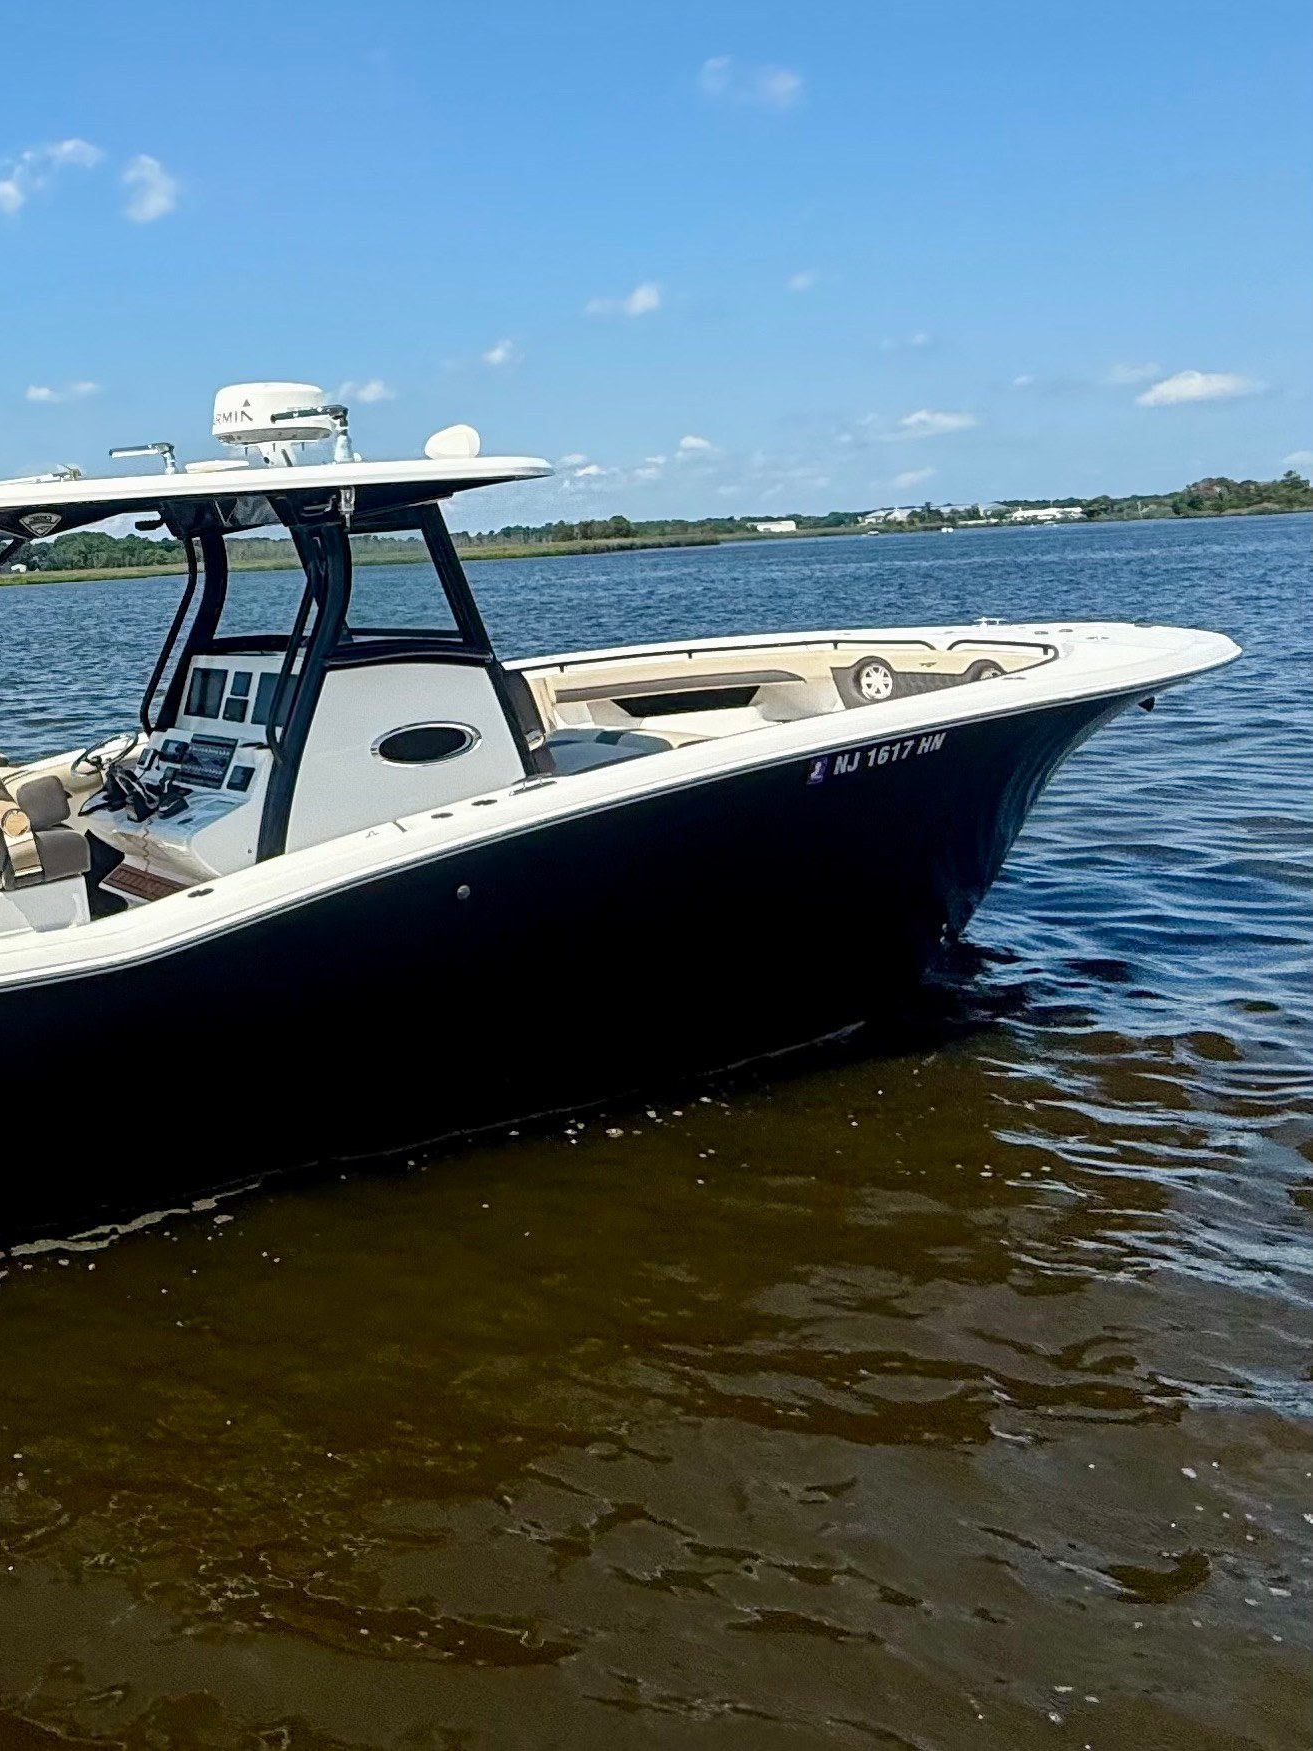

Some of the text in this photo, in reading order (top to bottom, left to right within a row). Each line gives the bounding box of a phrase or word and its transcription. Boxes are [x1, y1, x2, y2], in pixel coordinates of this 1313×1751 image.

[213, 410, 254, 425] RMIN
[833, 732, 947, 775] NJ 1617 HN
